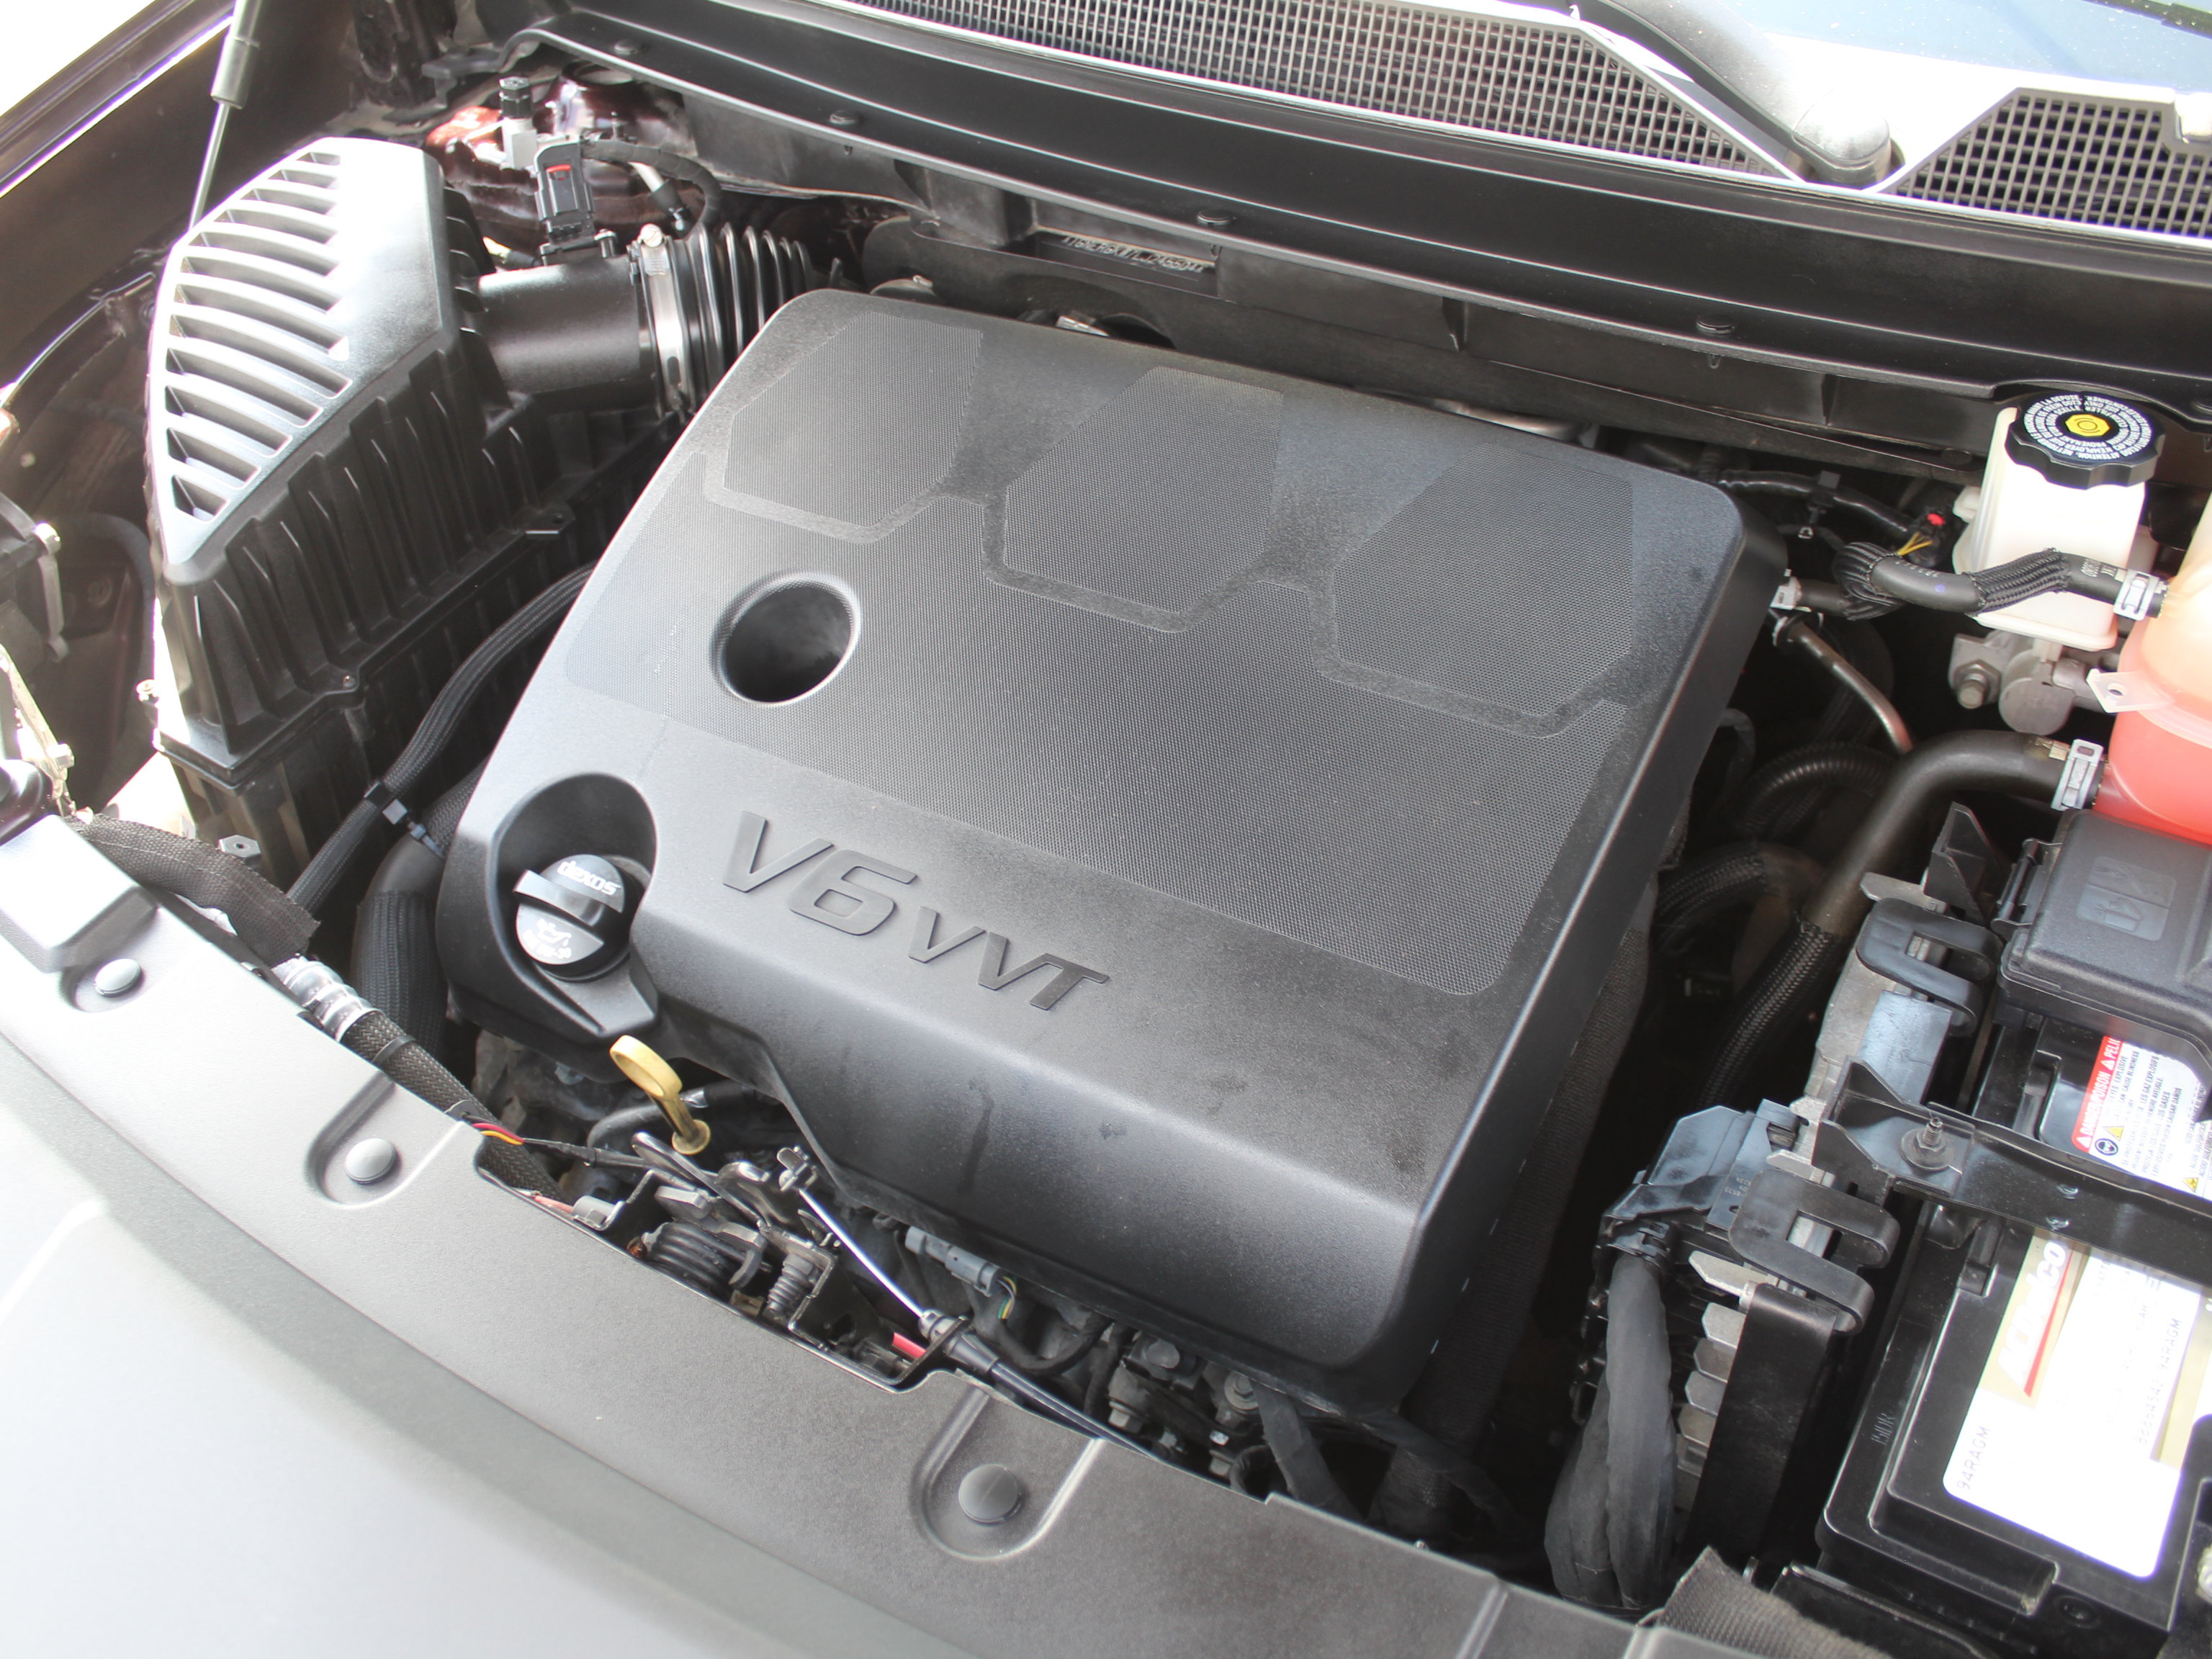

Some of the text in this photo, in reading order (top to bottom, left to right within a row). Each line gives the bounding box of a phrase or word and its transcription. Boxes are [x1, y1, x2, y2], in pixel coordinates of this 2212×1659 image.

[2041, 402, 2064, 412] FREIN
[2085, 406, 2113, 415] FILLER
[2103, 404, 2121, 413] USE
[2034, 437, 2073, 456] NETTOYER
[2046, 436, 2067, 446] QUE
[2058, 435, 2108, 447] PROVENANT
[557, 860, 622, 896] dexos
[722, 809, 1108, 1010] V6 VVT
[2114, 1055, 2128, 1082] EXPLOSIVE
[2121, 1076, 2131, 1092] CAUSE
[2126, 1051, 2140, 1076] BLINDNESS
[2146, 1055, 2159, 1082] EXPLOSIFS
[2142, 1082, 2151, 1093] GAZ
[2081, 1071, 2111, 1136] DANGER/POISON
[2161, 1091, 2170, 1108] GASES
[2167, 1104, 2177, 1123] CAUSAR
[1998, 1240, 2067, 1387] ACDelco
[2158, 1318, 2182, 1371] 94RAGM
[1957, 1426, 1990, 1489] 94RAGM
